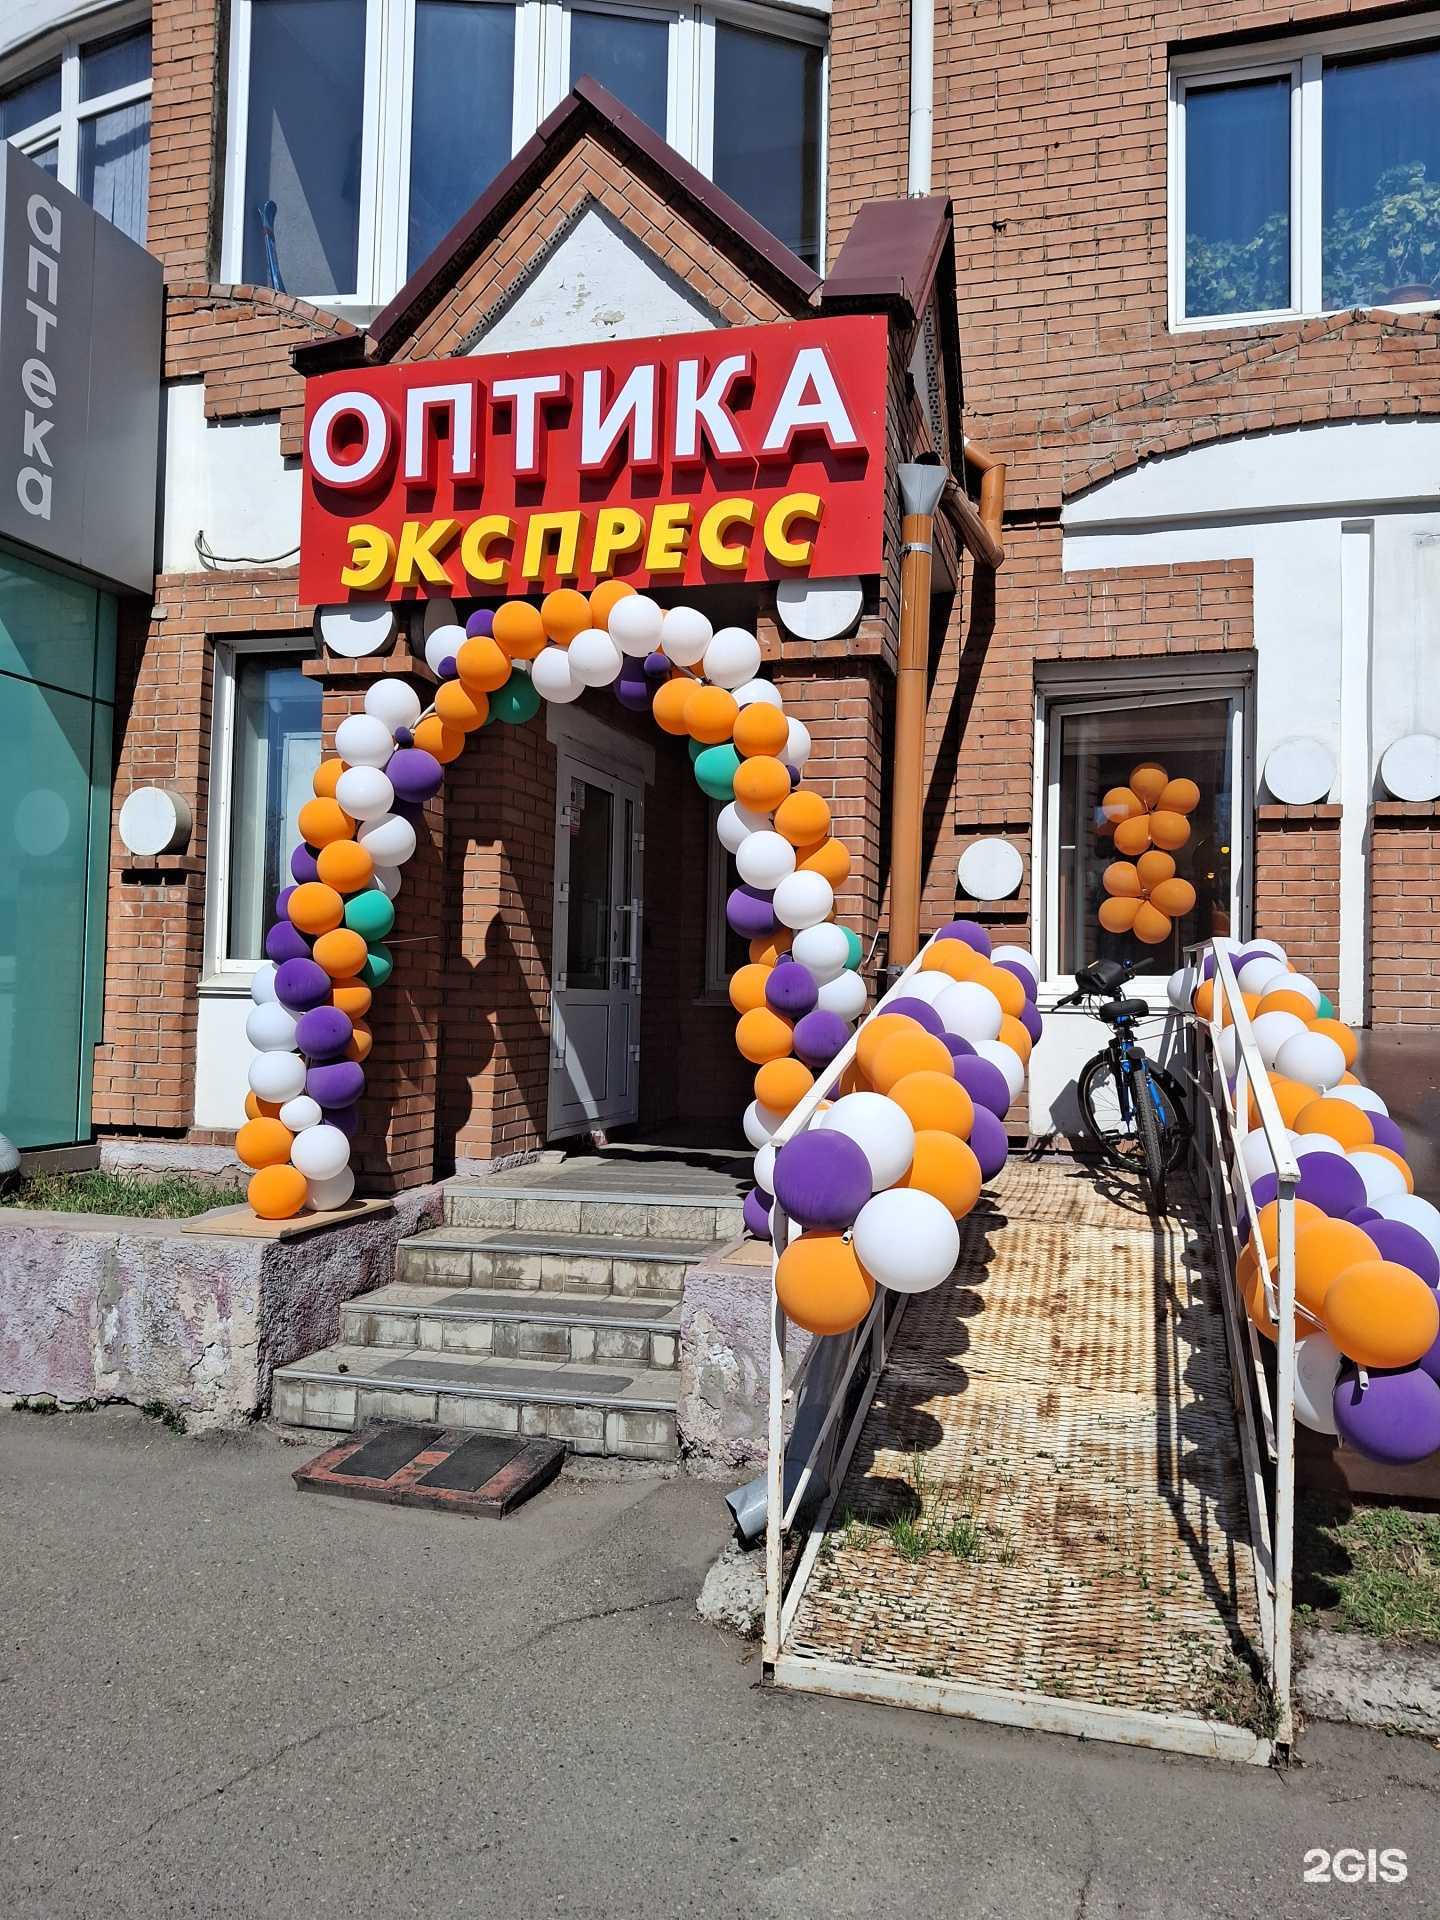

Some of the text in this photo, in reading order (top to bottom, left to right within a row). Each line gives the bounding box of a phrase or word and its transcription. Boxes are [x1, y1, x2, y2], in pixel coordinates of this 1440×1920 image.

[16, 193, 62, 521] аптека
[308, 347, 858, 484] ОПТИКА
[340, 492, 822, 588] ЭКСПРЕСС
